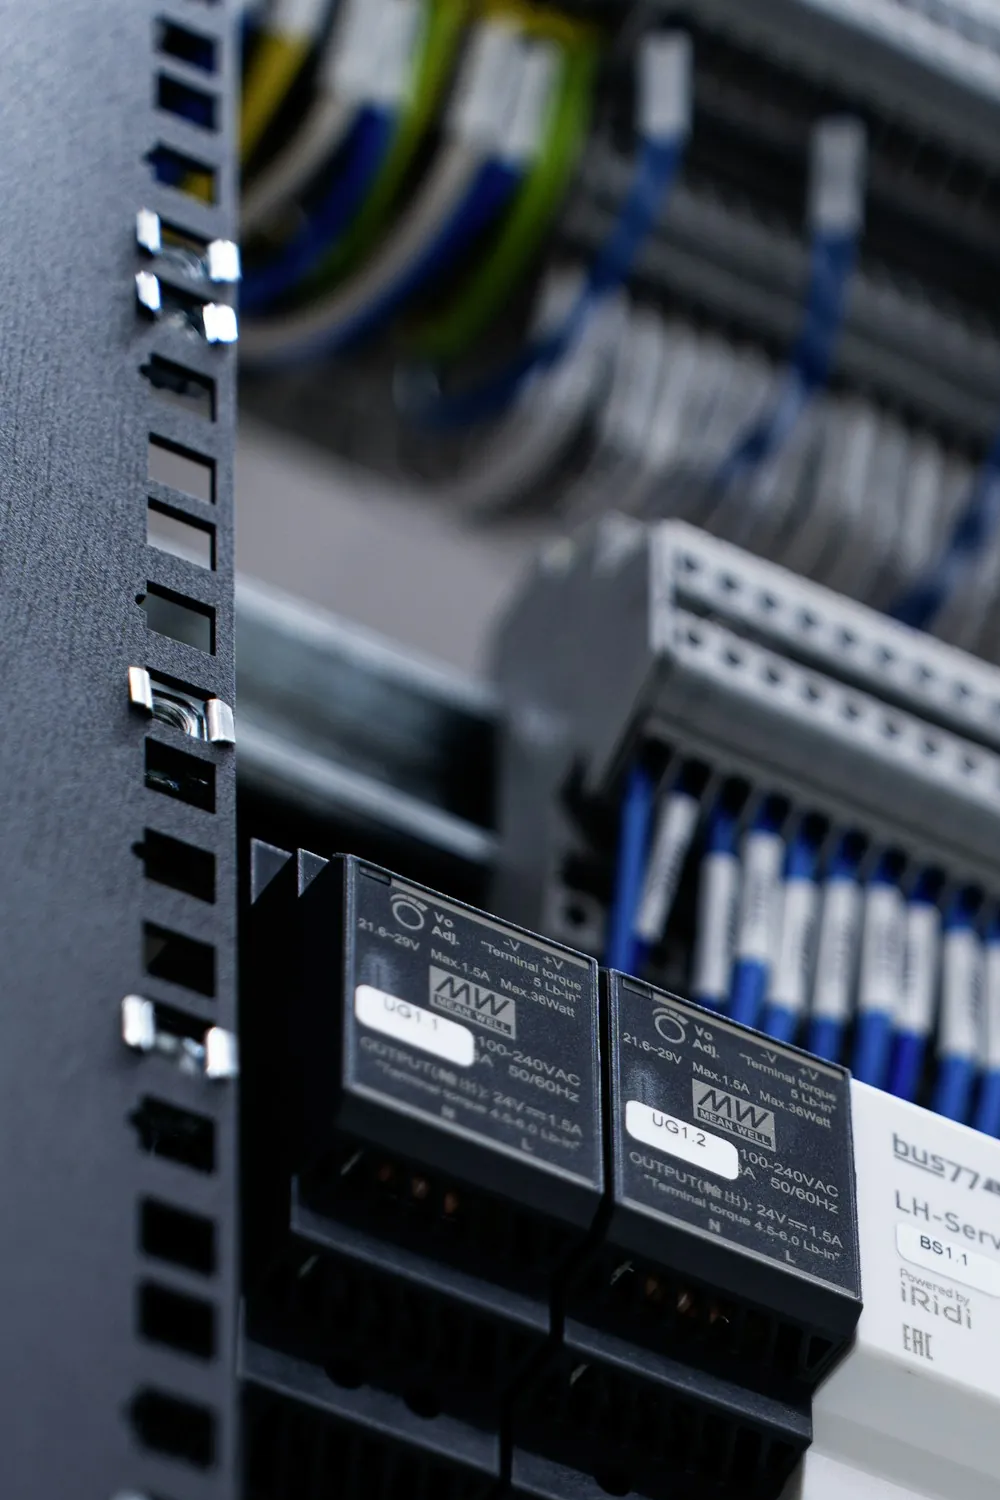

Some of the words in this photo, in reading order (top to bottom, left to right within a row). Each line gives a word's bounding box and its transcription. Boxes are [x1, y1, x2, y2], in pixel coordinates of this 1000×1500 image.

[434, 911, 453, 928] Vo
[542, 967, 582, 991] torque
[475, 1011, 510, 1033] WELL
[694, 1024, 713, 1041] Vo
[692, 1039, 720, 1058] Adj.
[509, 1064, 580, 1102] 50/60Hz
[692, 1061, 750, 1095] Max.1.5A
[760, 1090, 831, 1128] Max.36Watt
[798, 1079, 837, 1102] torque
[652, 1112, 706, 1148] UG1.2
[700, 1110, 733, 1130] MEAN
[736, 1125, 769, 1145] WELL
[740, 1149, 839, 1197] 100-240VAC
[893, 1132, 980, 1191] bus77
[770, 1177, 839, 1214] 50/60Hz
[708, 1218, 720, 1232] N
[709, 1202, 751, 1226] torque
[786, 1250, 796, 1264] L
[920, 1235, 967, 1266] BS1.1
[900, 1268, 953, 1298] Powered
[955, 1290, 970, 1306] by
[901, 1281, 972, 1330] iRidi
